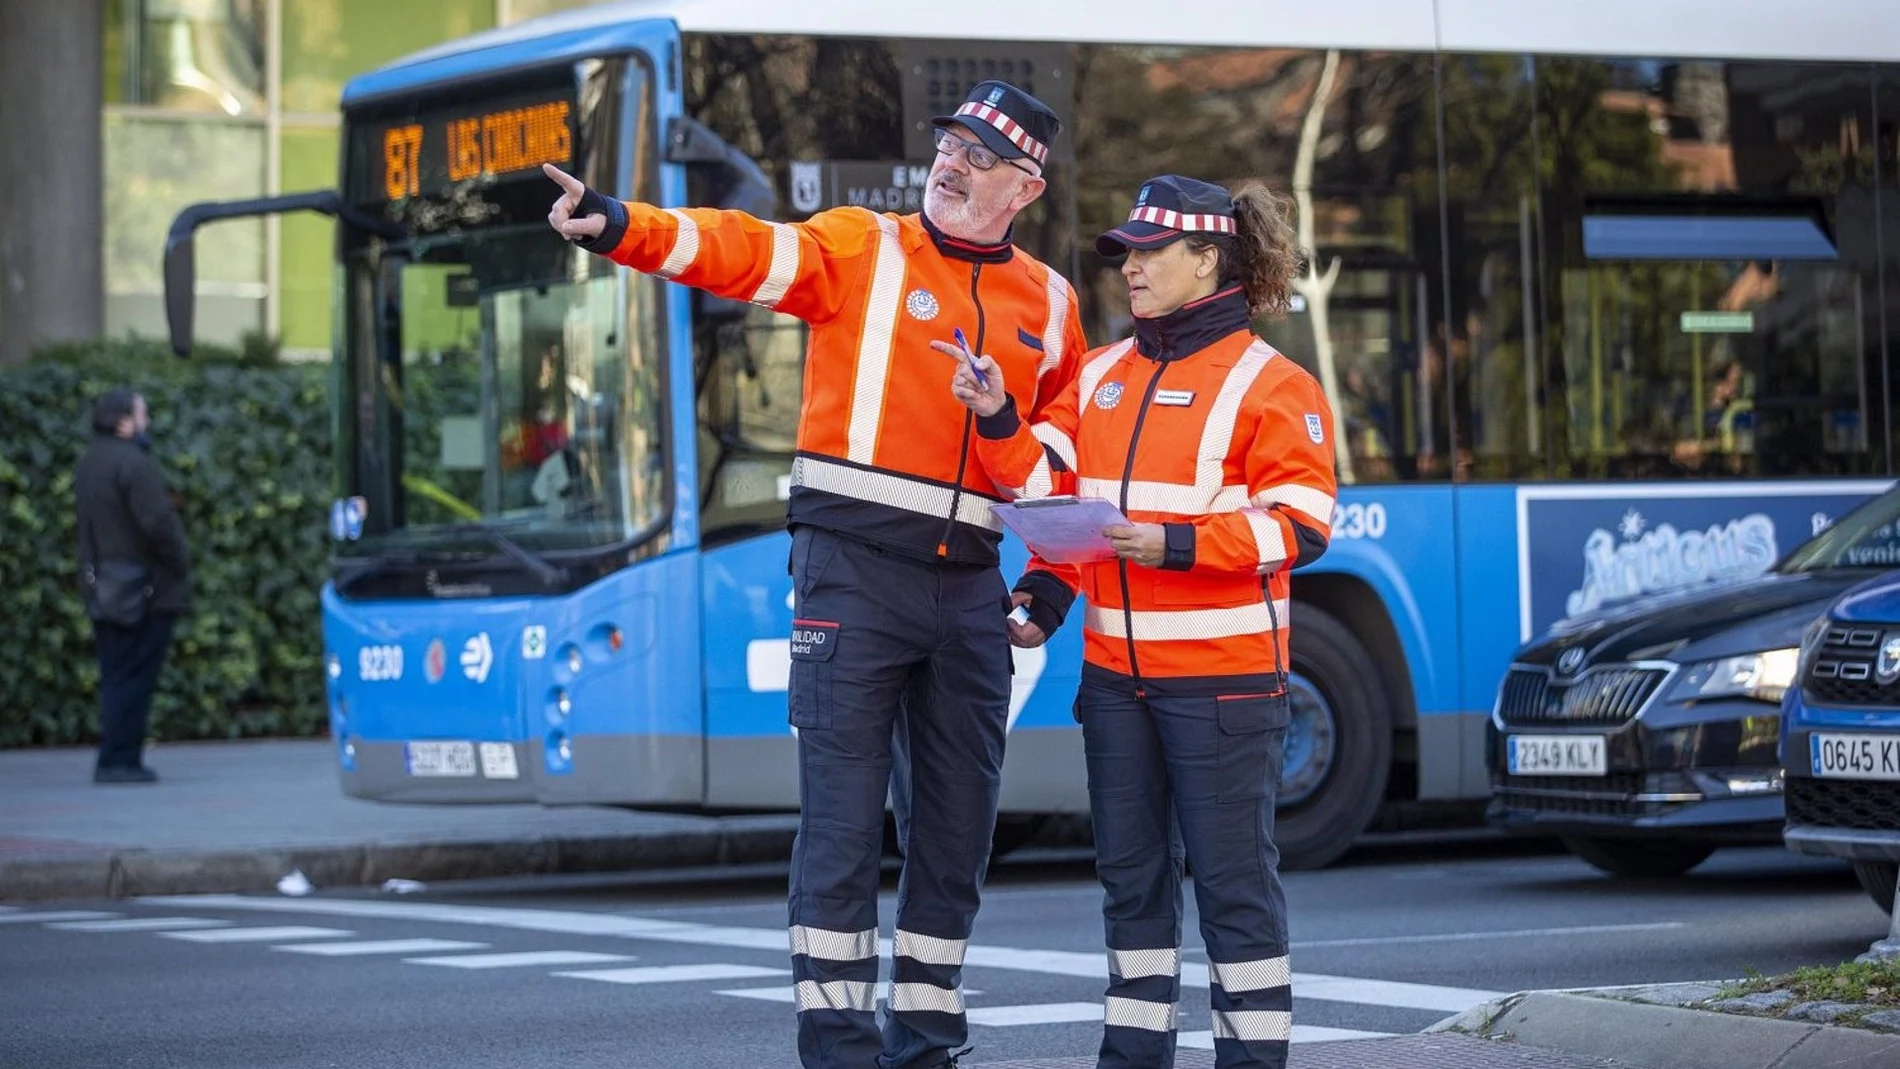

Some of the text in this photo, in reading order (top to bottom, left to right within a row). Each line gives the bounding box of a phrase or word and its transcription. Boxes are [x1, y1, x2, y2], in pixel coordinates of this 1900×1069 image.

[383, 124, 424, 201] 87
[893, 165, 929, 188] EM
[848, 186, 926, 210] MADR
[1330, 503, 1387, 540] 230
[359, 645, 404, 681] 9230
[1565, 741, 1598, 769] KLY
[1823, 741, 1874, 772] 0645
